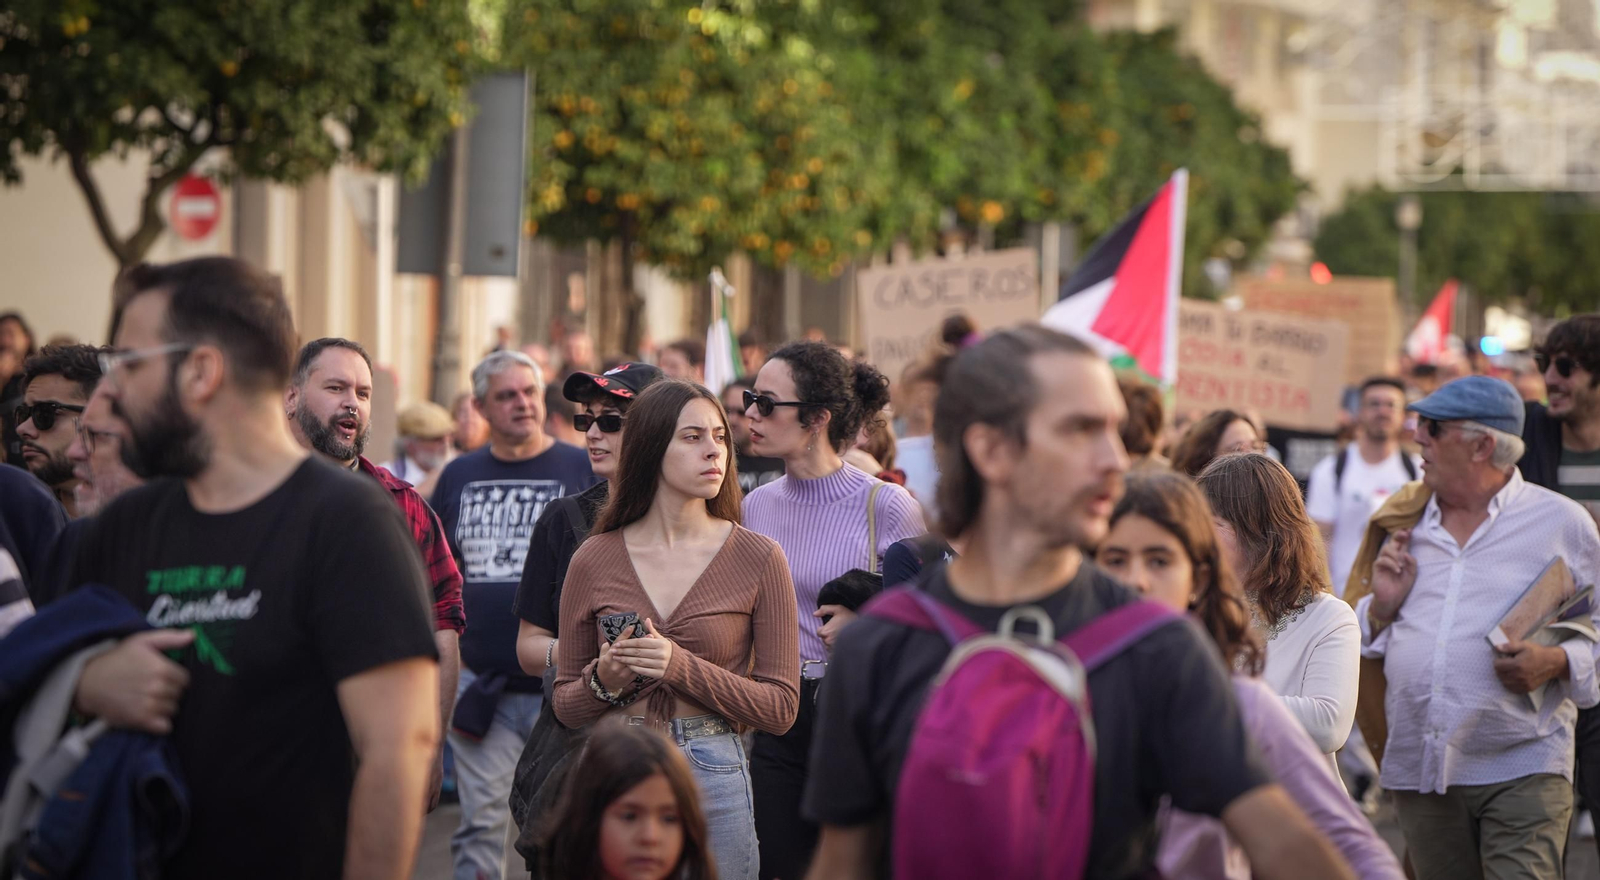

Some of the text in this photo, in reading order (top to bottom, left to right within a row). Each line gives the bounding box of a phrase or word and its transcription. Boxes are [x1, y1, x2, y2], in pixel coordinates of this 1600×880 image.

[873, 265, 1035, 310] CASEROS
[1177, 370, 1311, 413] RENTISTA
[461, 501, 548, 526] ROCK STA
